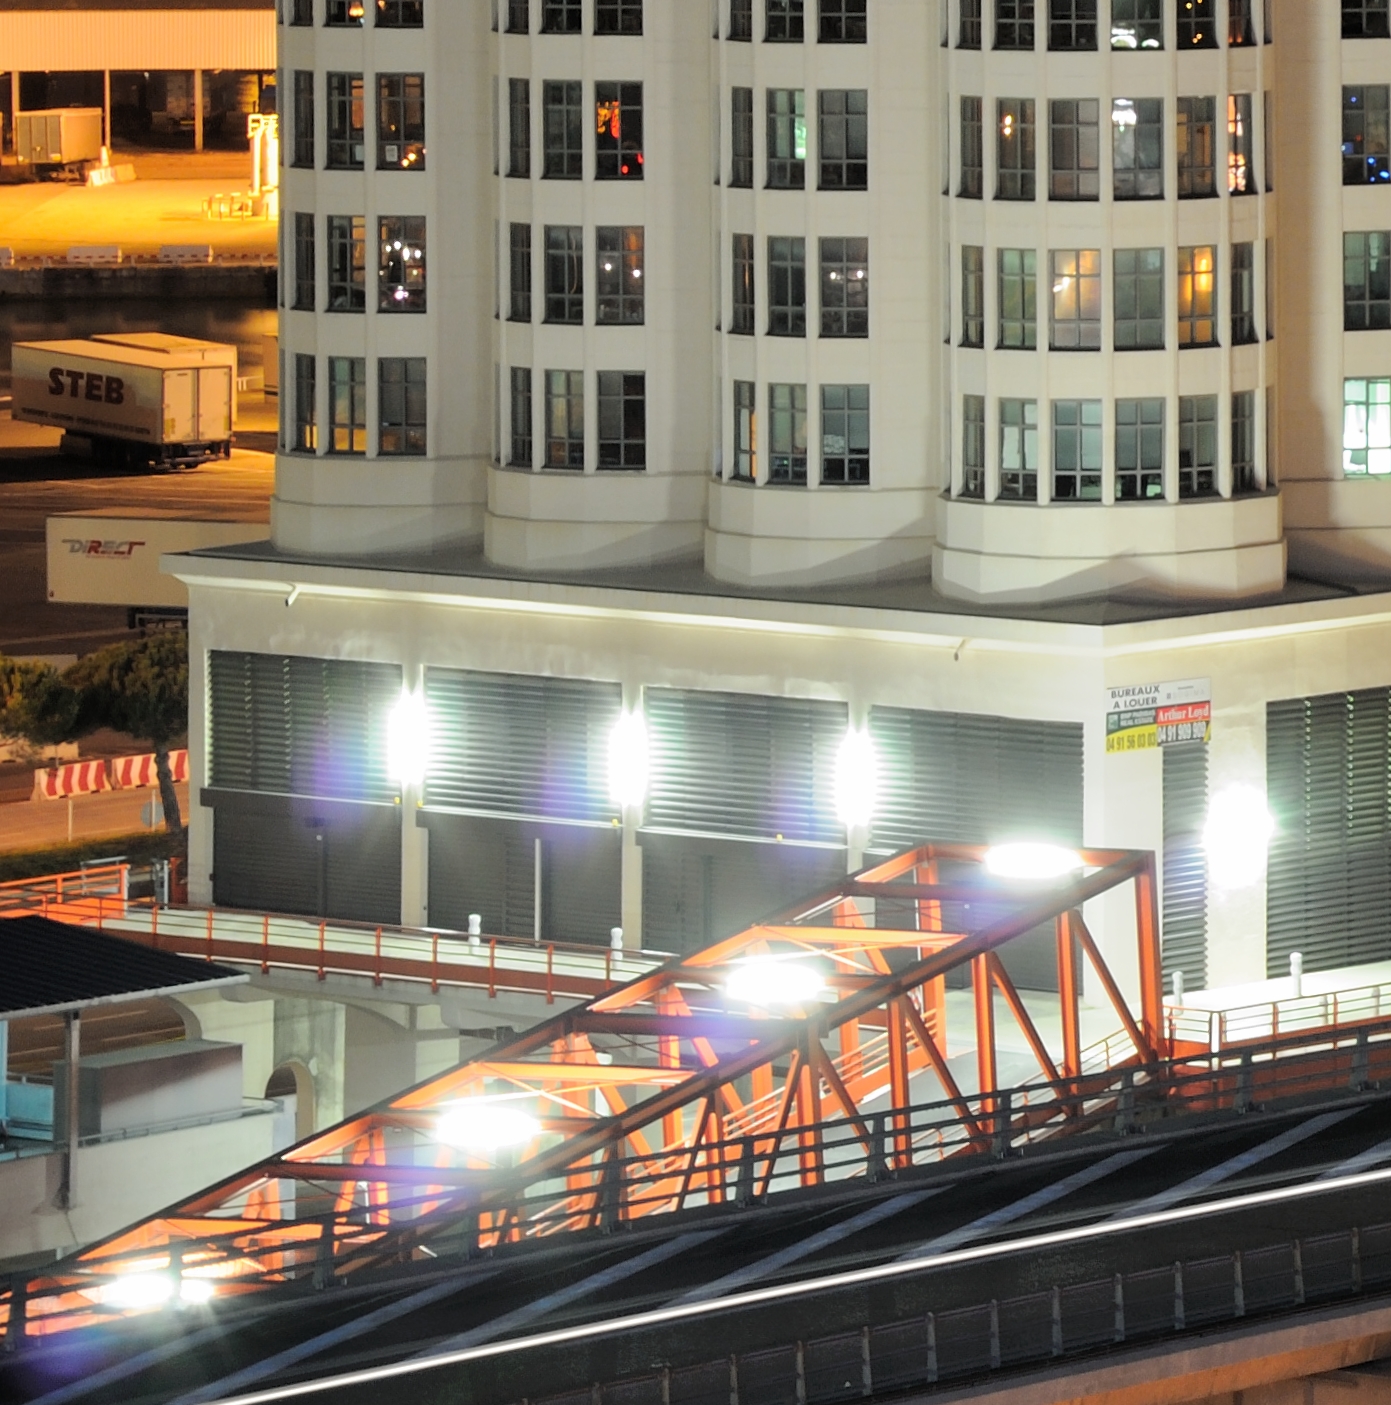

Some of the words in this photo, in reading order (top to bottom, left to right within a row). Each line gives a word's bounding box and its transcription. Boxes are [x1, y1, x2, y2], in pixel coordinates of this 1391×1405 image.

[48, 366, 125, 405] STEB
[62, 539, 146, 555] DIRECT
[1111, 685, 1160, 699] BUREAUX
[1113, 701, 1121, 710] A
[1124, 697, 1158, 709] LOUER
[1157, 706, 1187, 722] Arthur
